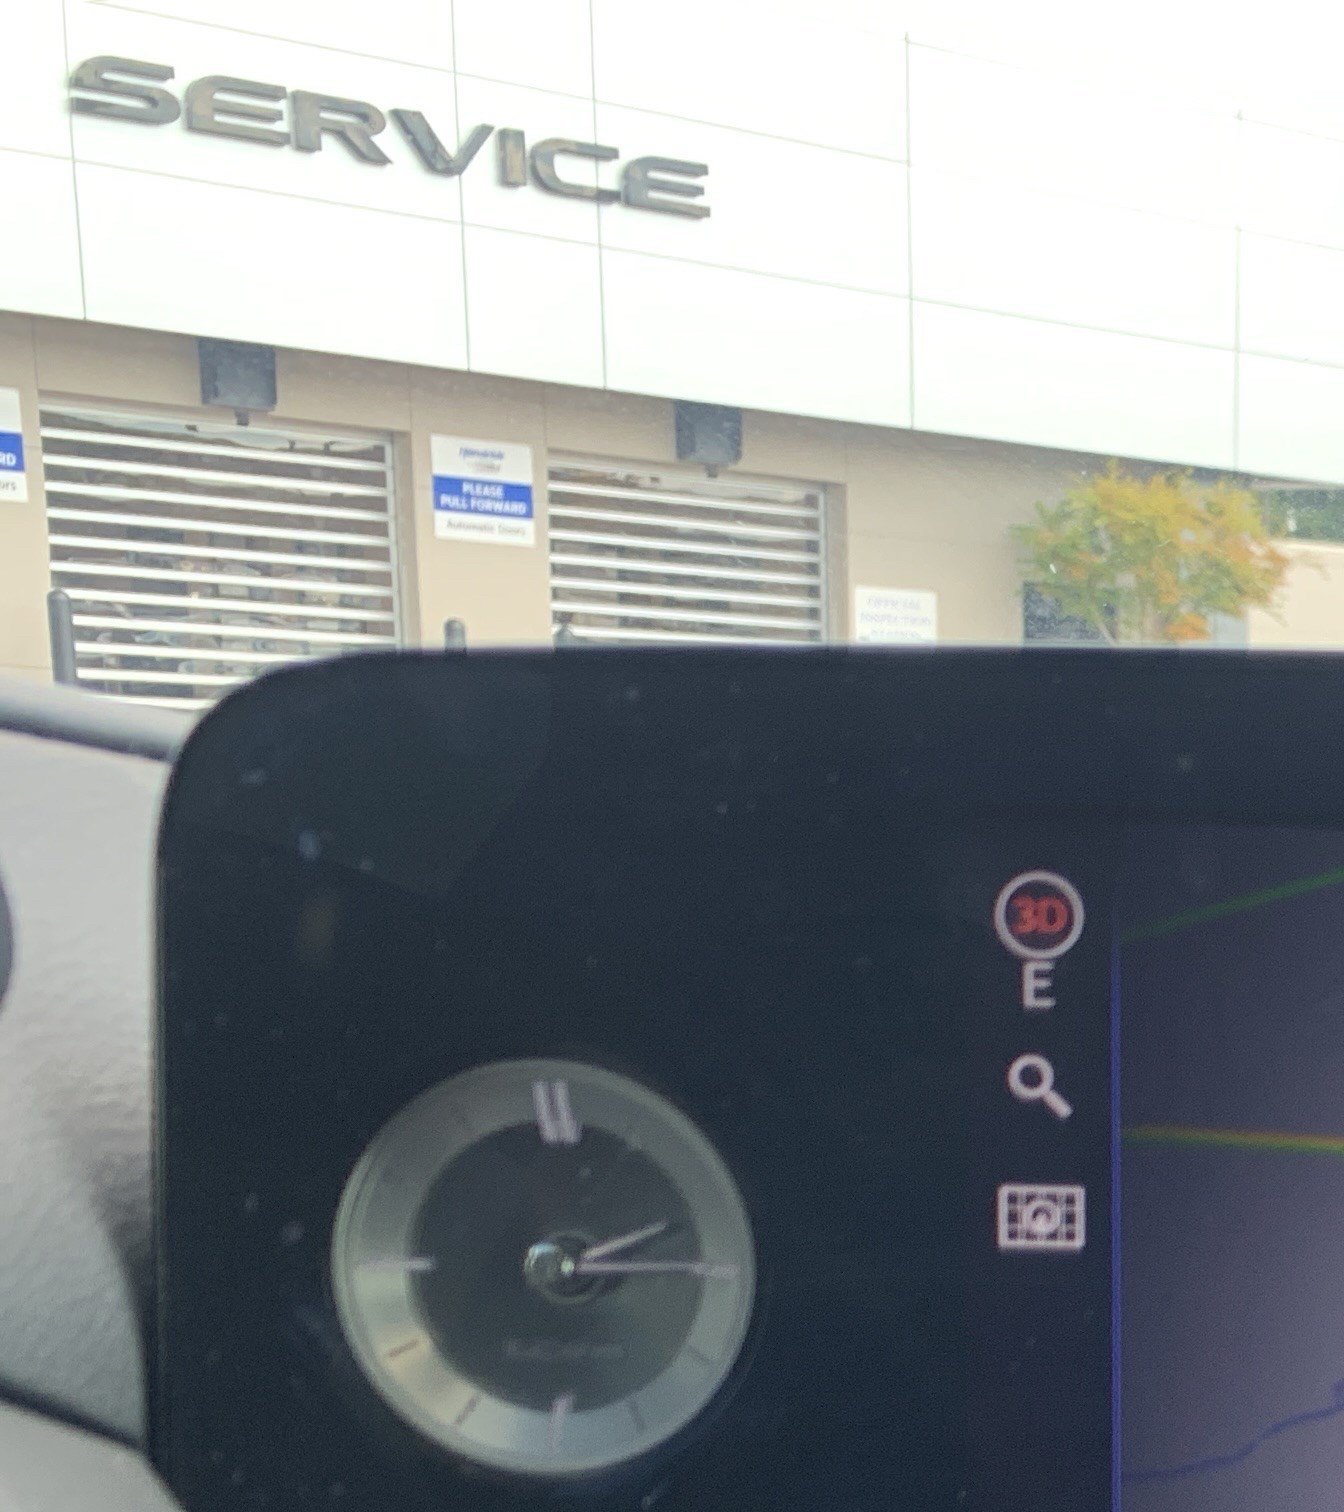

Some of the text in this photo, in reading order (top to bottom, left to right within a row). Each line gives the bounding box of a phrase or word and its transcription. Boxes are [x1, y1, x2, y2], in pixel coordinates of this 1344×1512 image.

[69, 55, 711, 219] SERVICE
[440, 494, 527, 516] PULL FORWARD
[462, 481, 504, 500] PLEASE
[1023, 960, 1057, 1010] E
